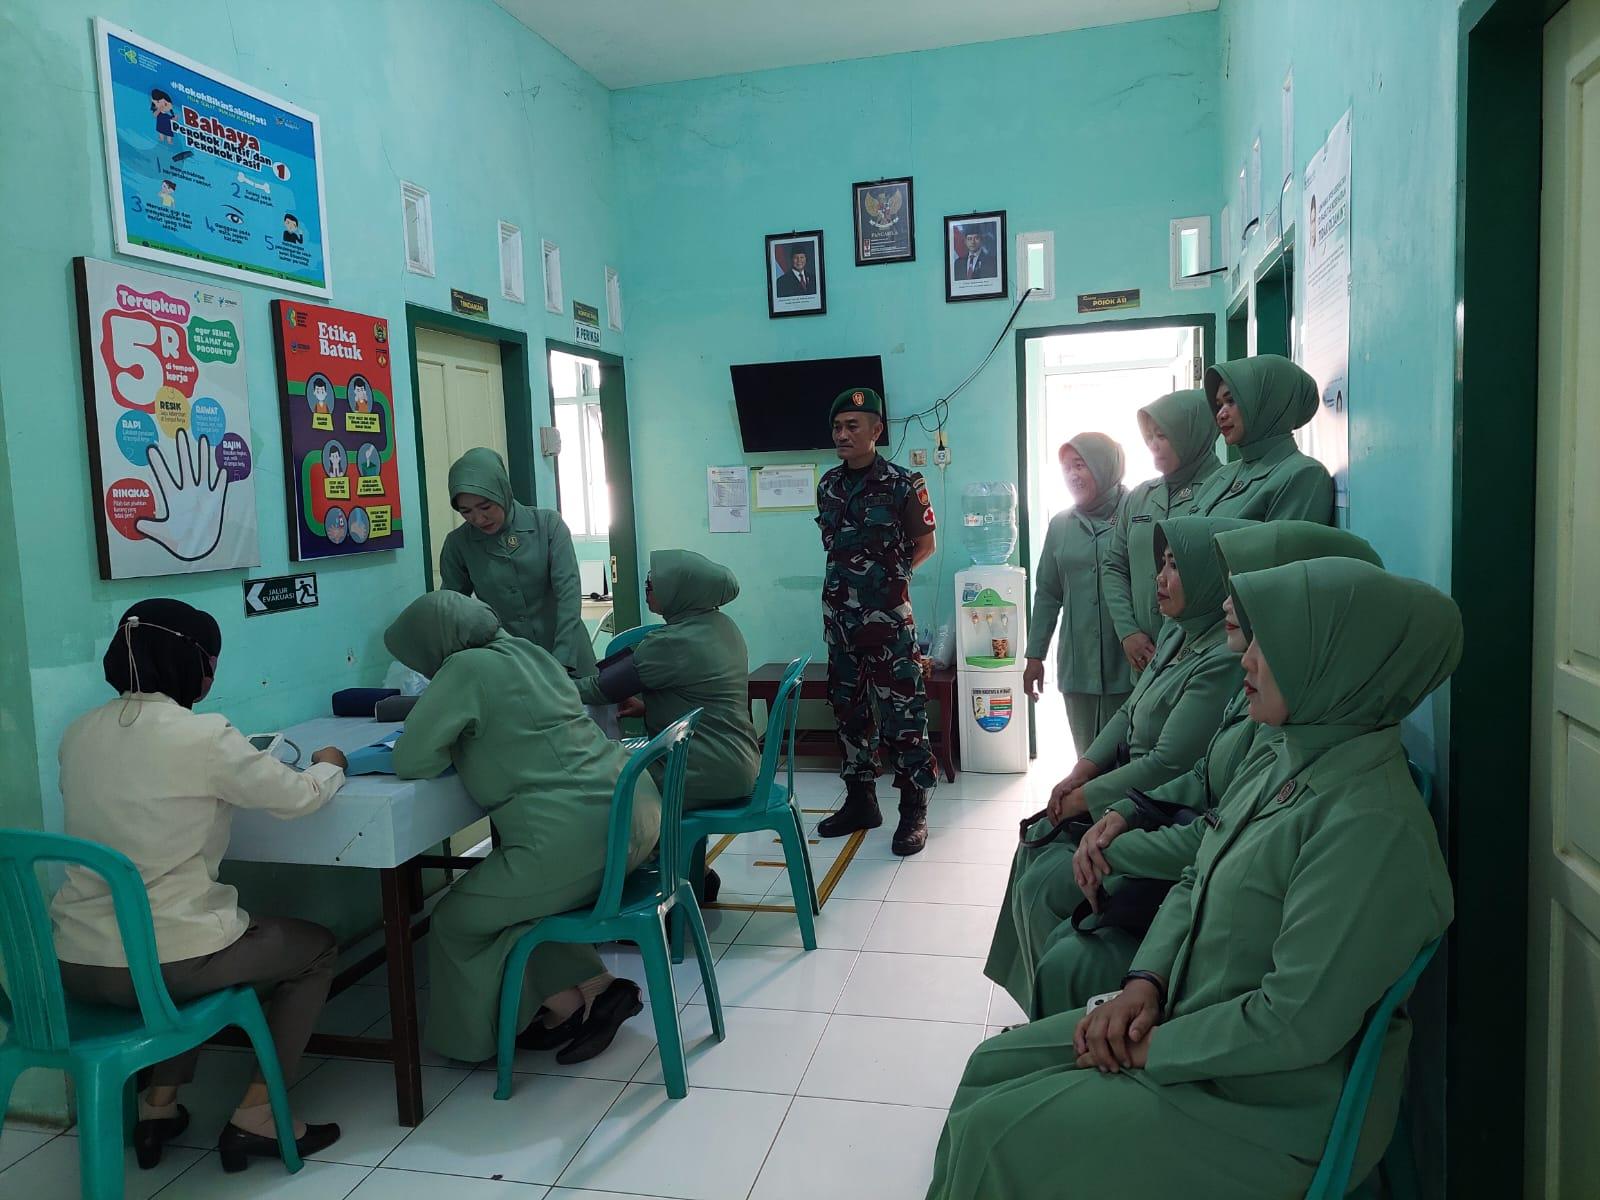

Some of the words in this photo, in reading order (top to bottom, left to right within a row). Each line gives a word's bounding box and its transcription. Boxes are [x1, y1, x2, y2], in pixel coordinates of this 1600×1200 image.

[170, 80, 267, 127] #RokokBikinSakitHati
[183, 106, 260, 152] Bahaya
[172, 121, 220, 146] Perokok
[223, 141, 251, 158] Aktif
[253, 152, 272, 166] dan
[187, 137, 233, 161] Perokok
[236, 154, 261, 171] Pasif
[276, 163, 286, 180] 1
[231, 182, 241, 199] 2
[130, 195, 143, 213] 3
[205, 215, 216, 233] 4
[264, 234, 275, 251] 5
[118, 290, 187, 316] Terapkan
[460, 300, 484, 312] TINDAKAN
[1092, 298, 1115, 306] POJOK
[194, 328, 210, 336] agar
[317, 321, 358, 344] Etika
[193, 335, 221, 347] SELAMAT
[222, 340, 235, 349] dan
[196, 344, 232, 356] PRODUKTIF
[319, 339, 364, 361] Batuk
[110, 315, 164, 406] 5
[160, 326, 180, 360] R
[165, 362, 172, 371] di
[173, 363, 195, 374] tempat
[166, 371, 189, 383] kerja
[159, 400, 182, 411] RESIK
[195, 405, 219, 416] RAWAT
[121, 419, 142, 430] RAPI
[222, 440, 242, 451] RAJIN
[112, 488, 150, 499] RINGKAS
[262, 592, 295, 603] EVAKUASI
[268, 587, 288, 596] JALUR
